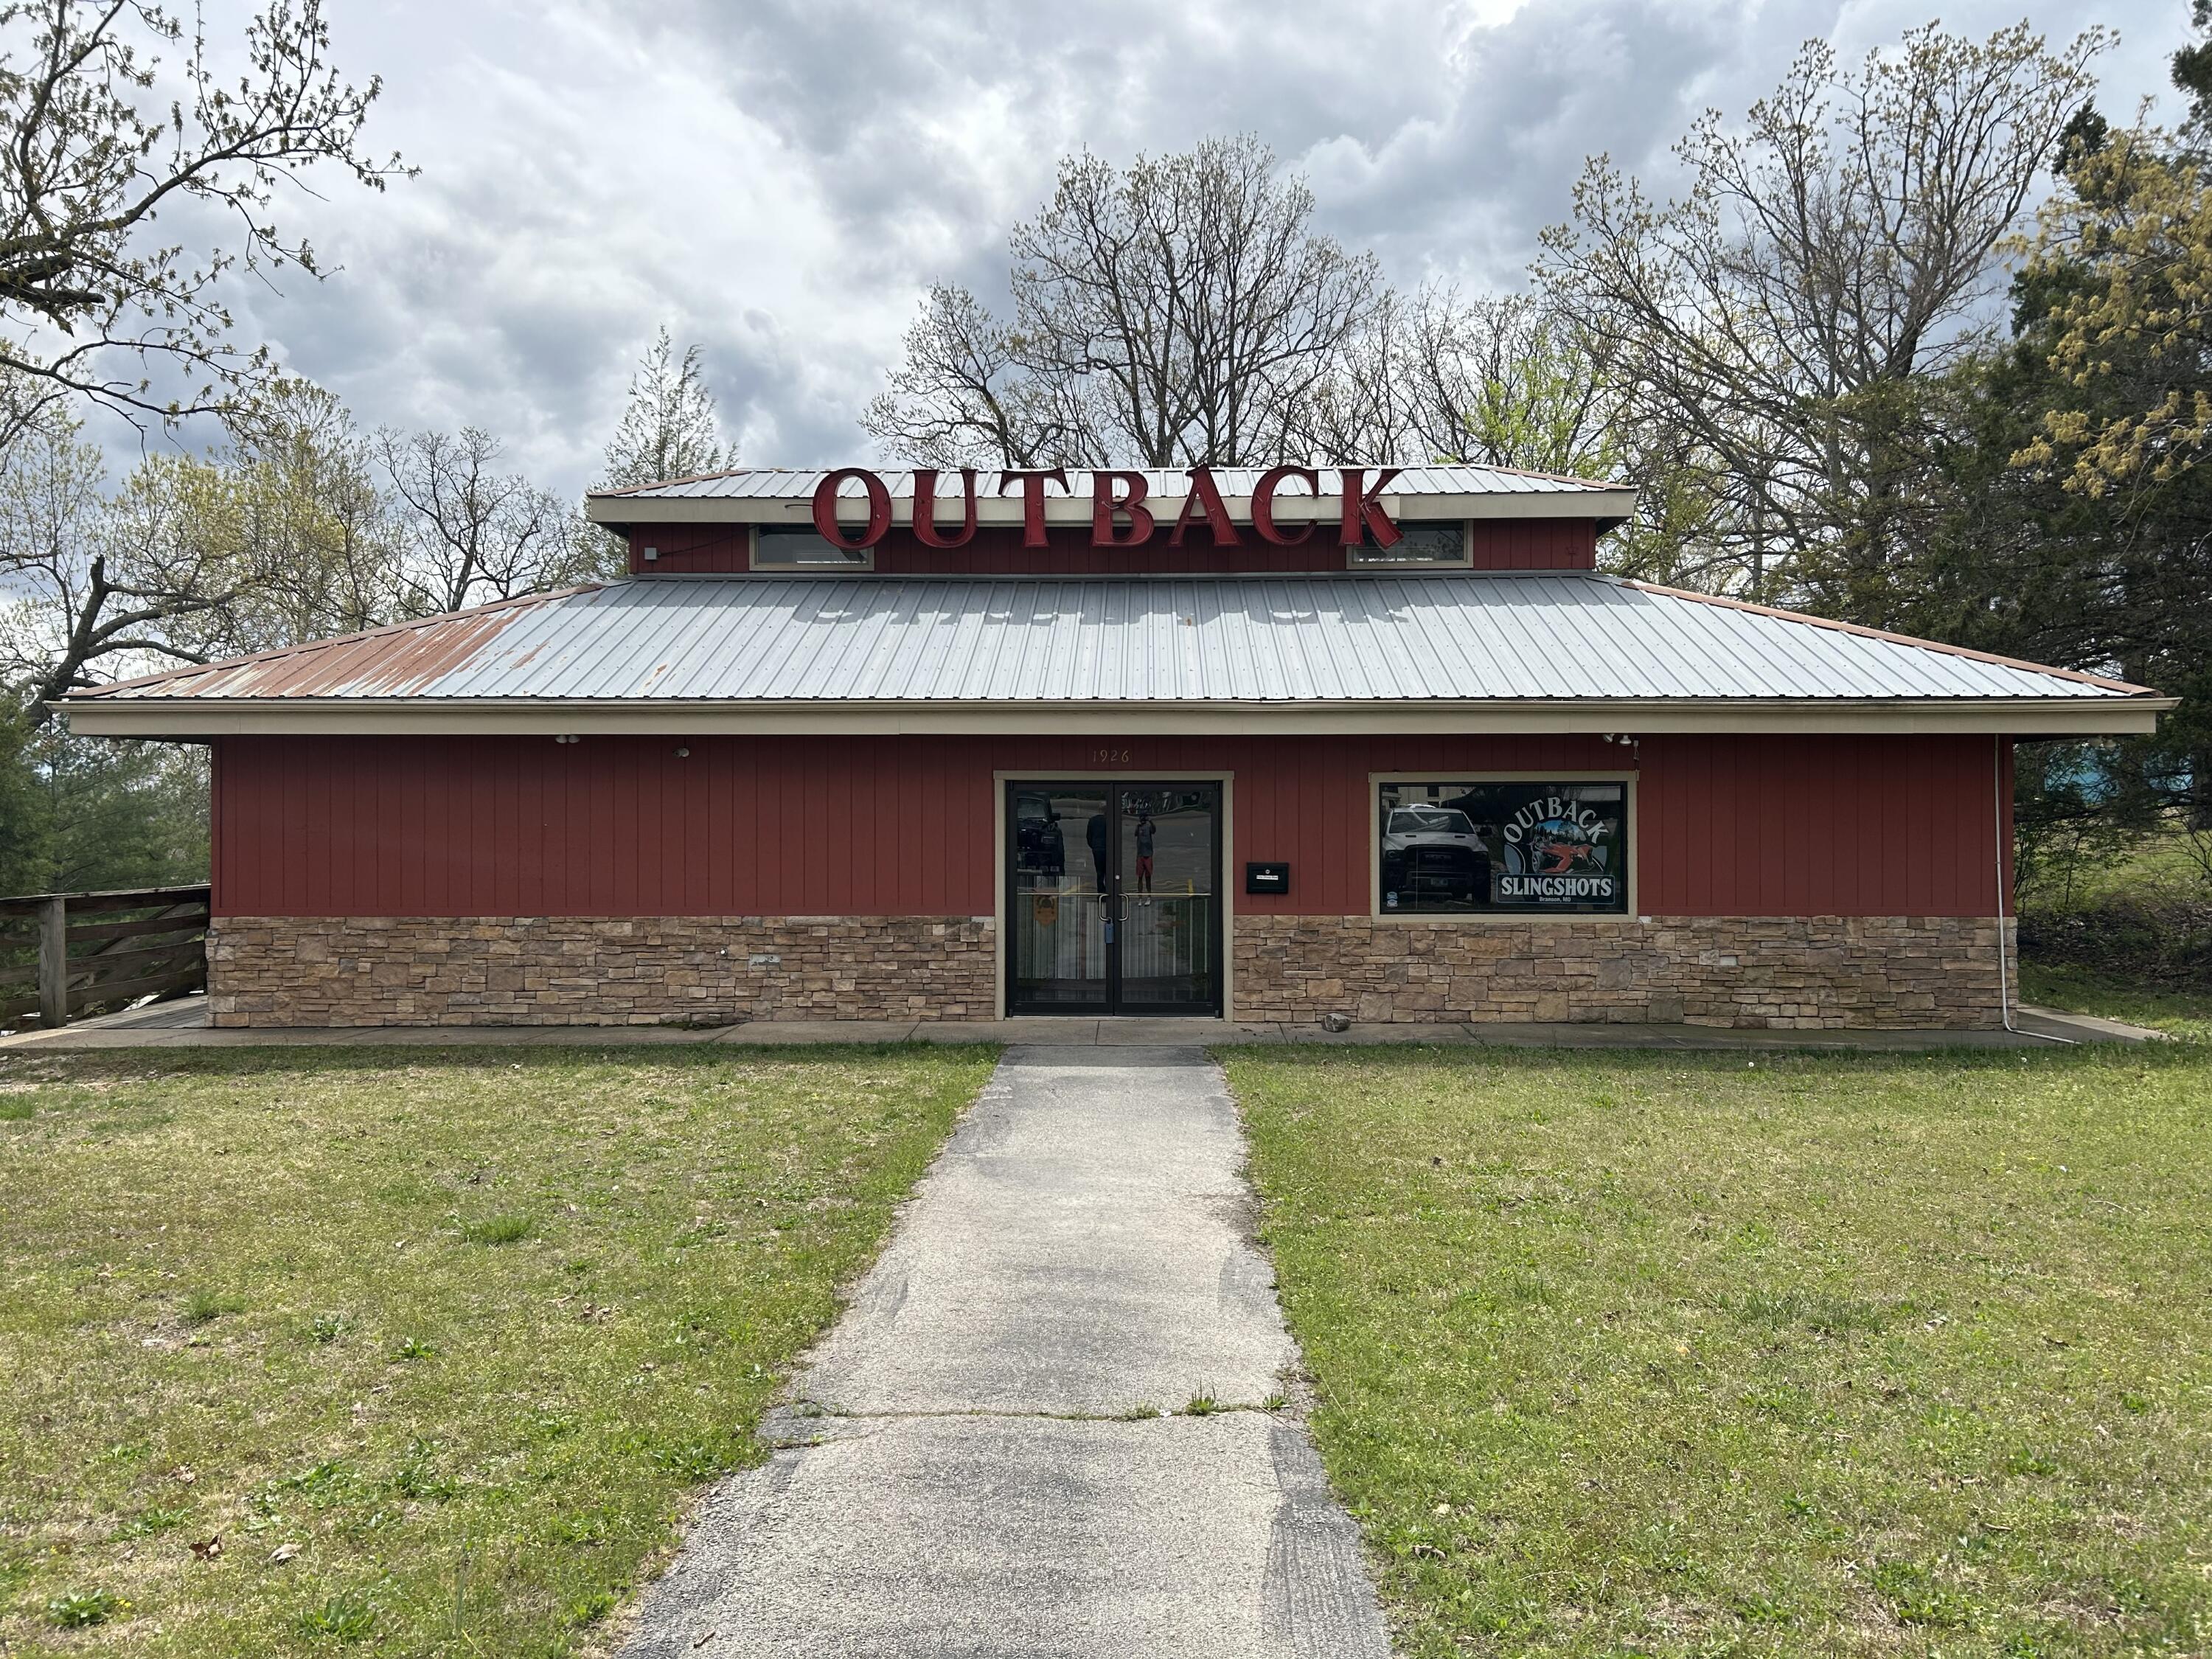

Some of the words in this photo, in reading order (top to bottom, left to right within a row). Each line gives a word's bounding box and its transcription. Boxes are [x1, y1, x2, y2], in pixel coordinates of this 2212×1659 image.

[812, 464, 1405, 550] OUTBACK
[1093, 749, 1129, 762] 1926
[1503, 796, 1610, 844] OUTBACK
[1501, 877, 1613, 897] SLINGSHOTS
